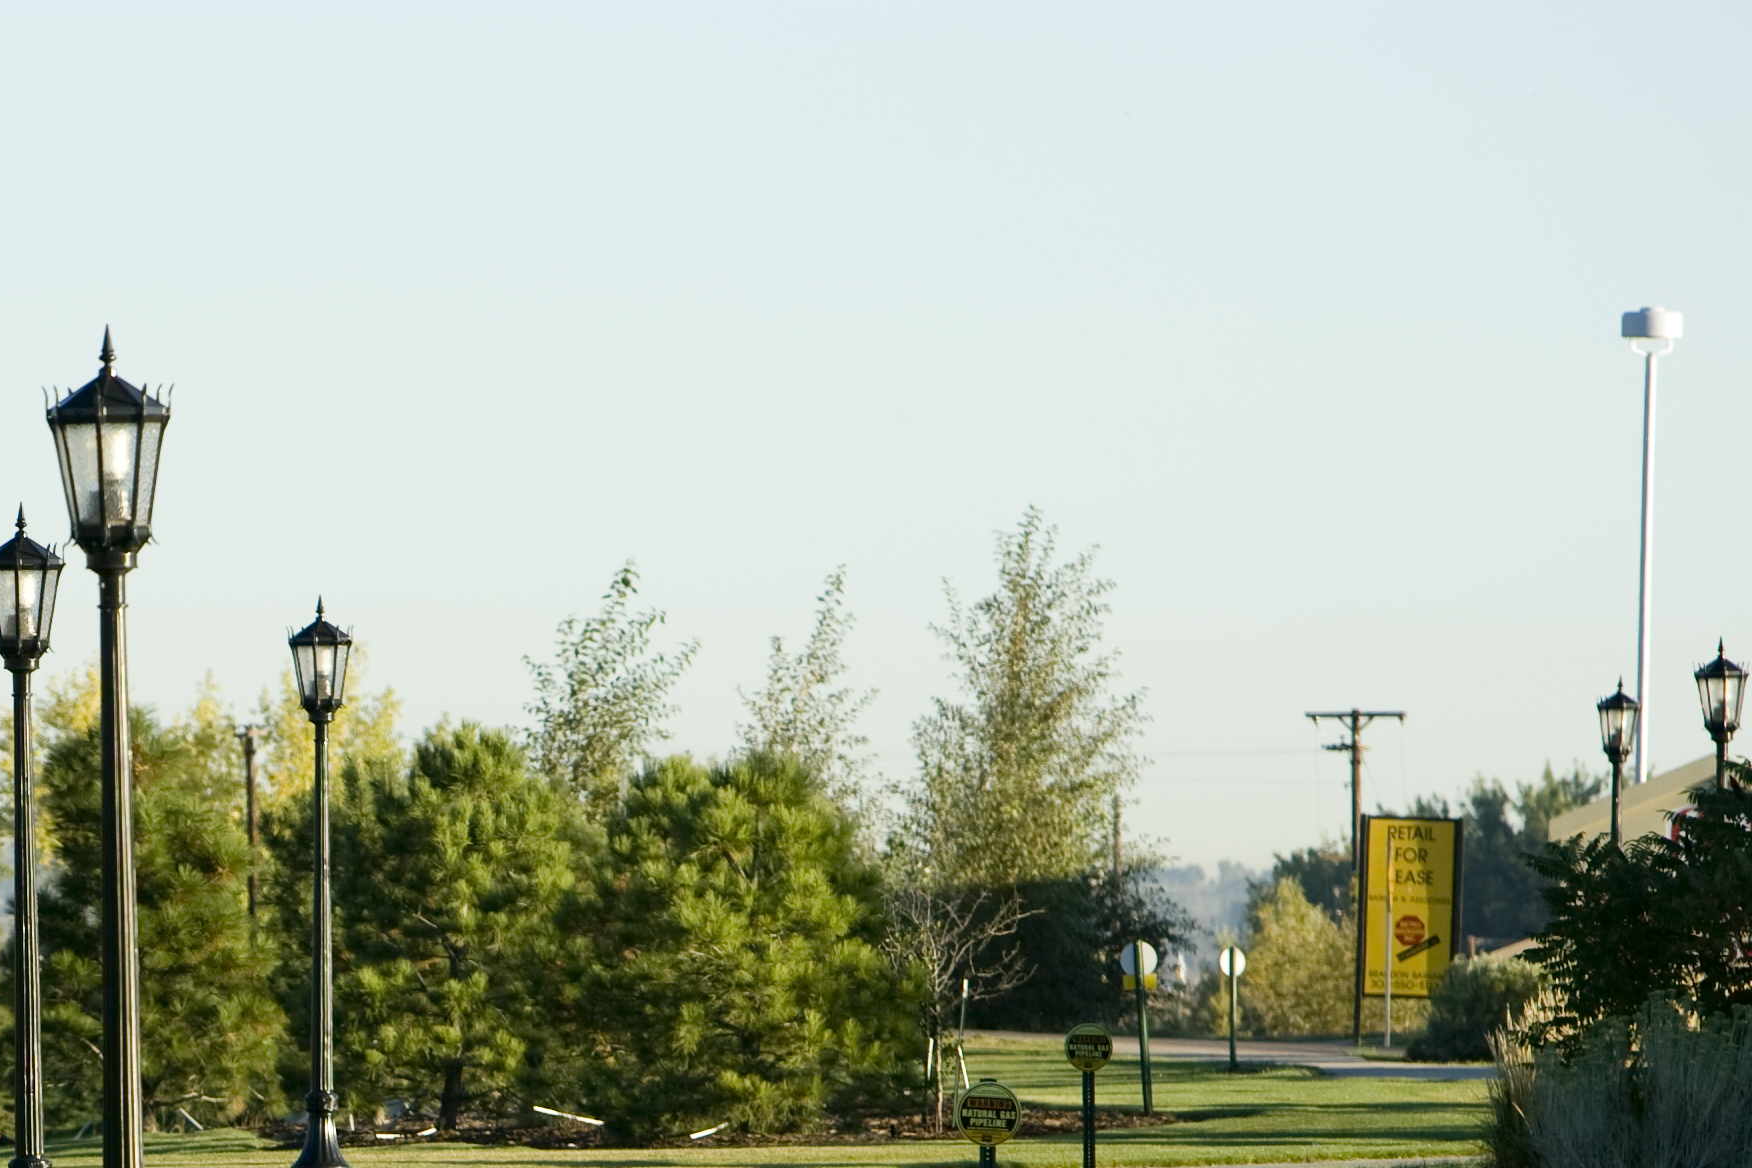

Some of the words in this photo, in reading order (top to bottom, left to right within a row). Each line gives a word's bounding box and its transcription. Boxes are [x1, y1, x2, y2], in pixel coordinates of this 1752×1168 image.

[1387, 825, 1436, 842] RETAIL
[1395, 846, 1428, 863] FOR
[1389, 868, 1434, 886] EASE
[962, 1108, 997, 1119] NATURAL
[999, 1110, 1017, 1120] GAS
[969, 1117, 1008, 1128] PIPELINE
